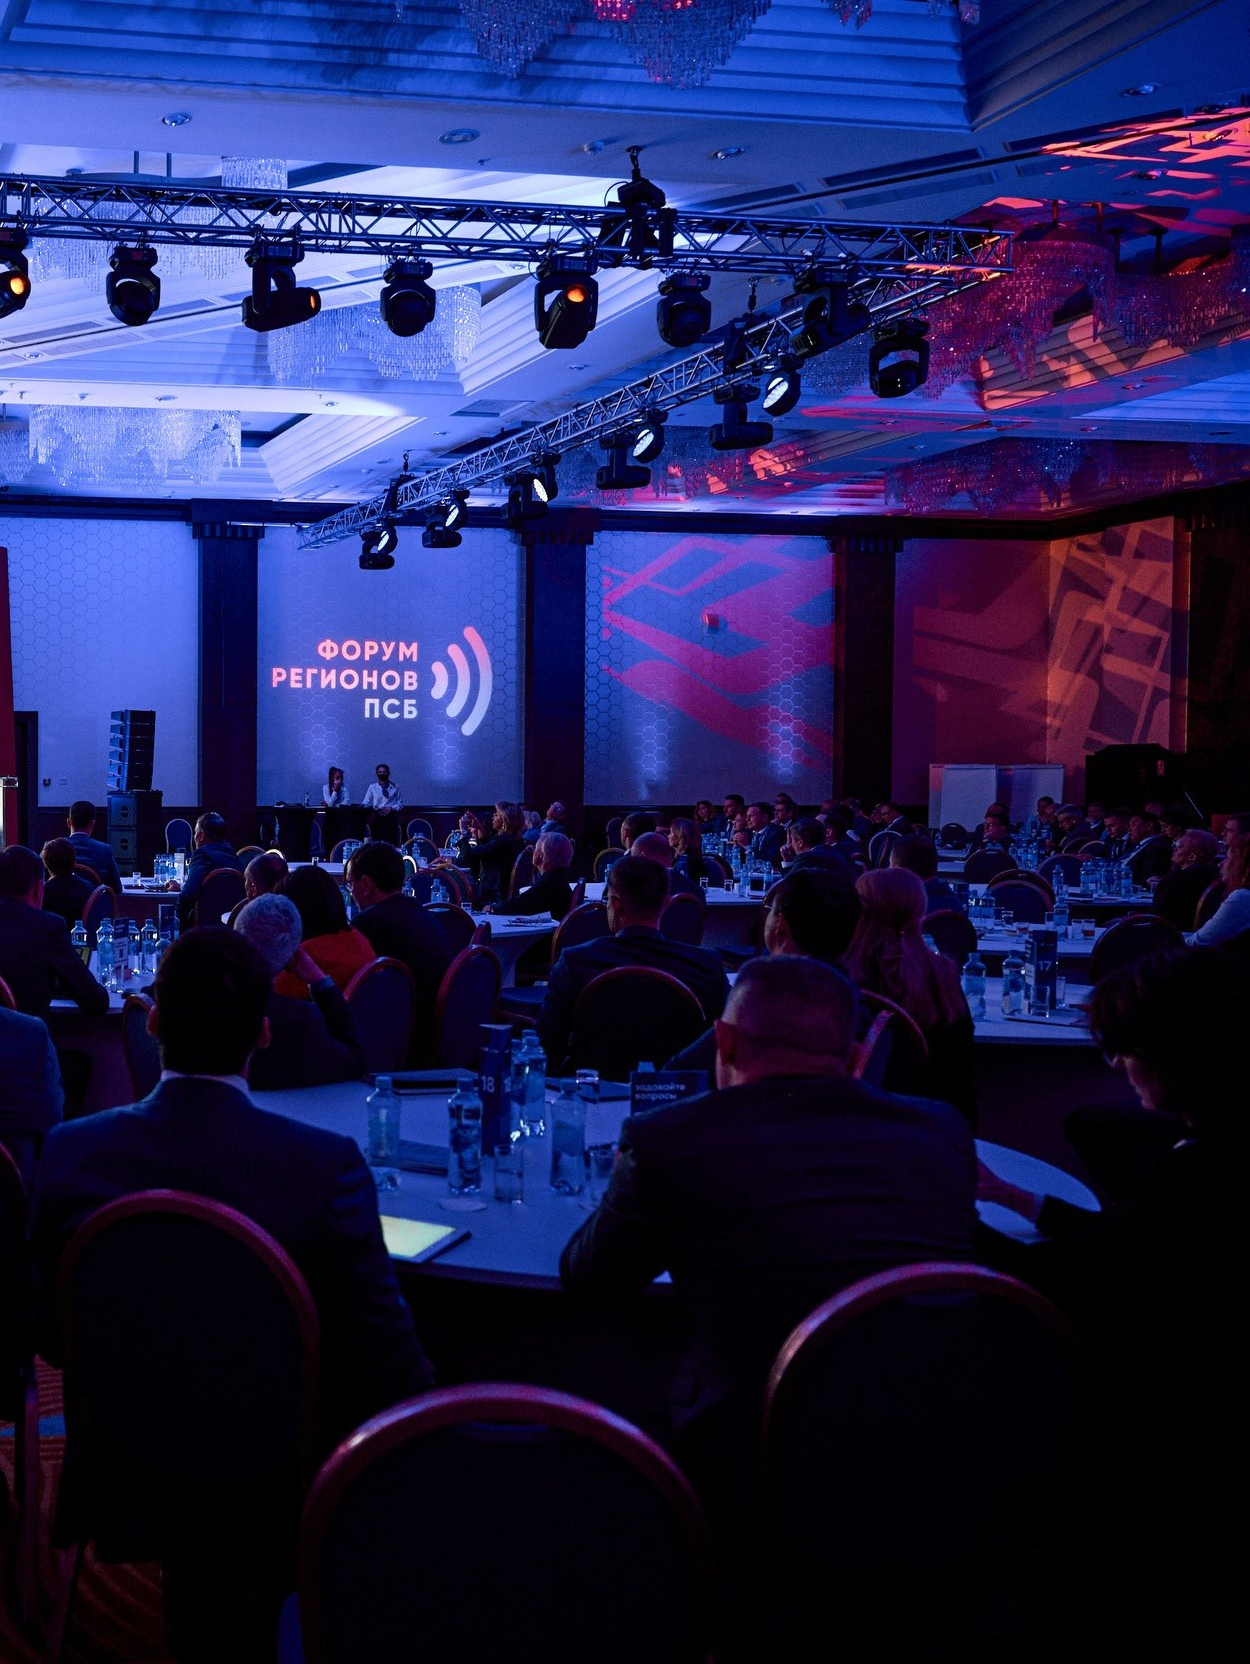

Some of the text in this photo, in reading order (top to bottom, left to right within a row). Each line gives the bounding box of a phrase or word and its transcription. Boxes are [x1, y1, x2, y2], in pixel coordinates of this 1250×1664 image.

[317, 639, 418, 662] ФОРУМ
[271, 667, 418, 691] РЕГИОНОВ
[364, 698, 418, 719] ПСБ
[481, 1075, 495, 1093] 18
